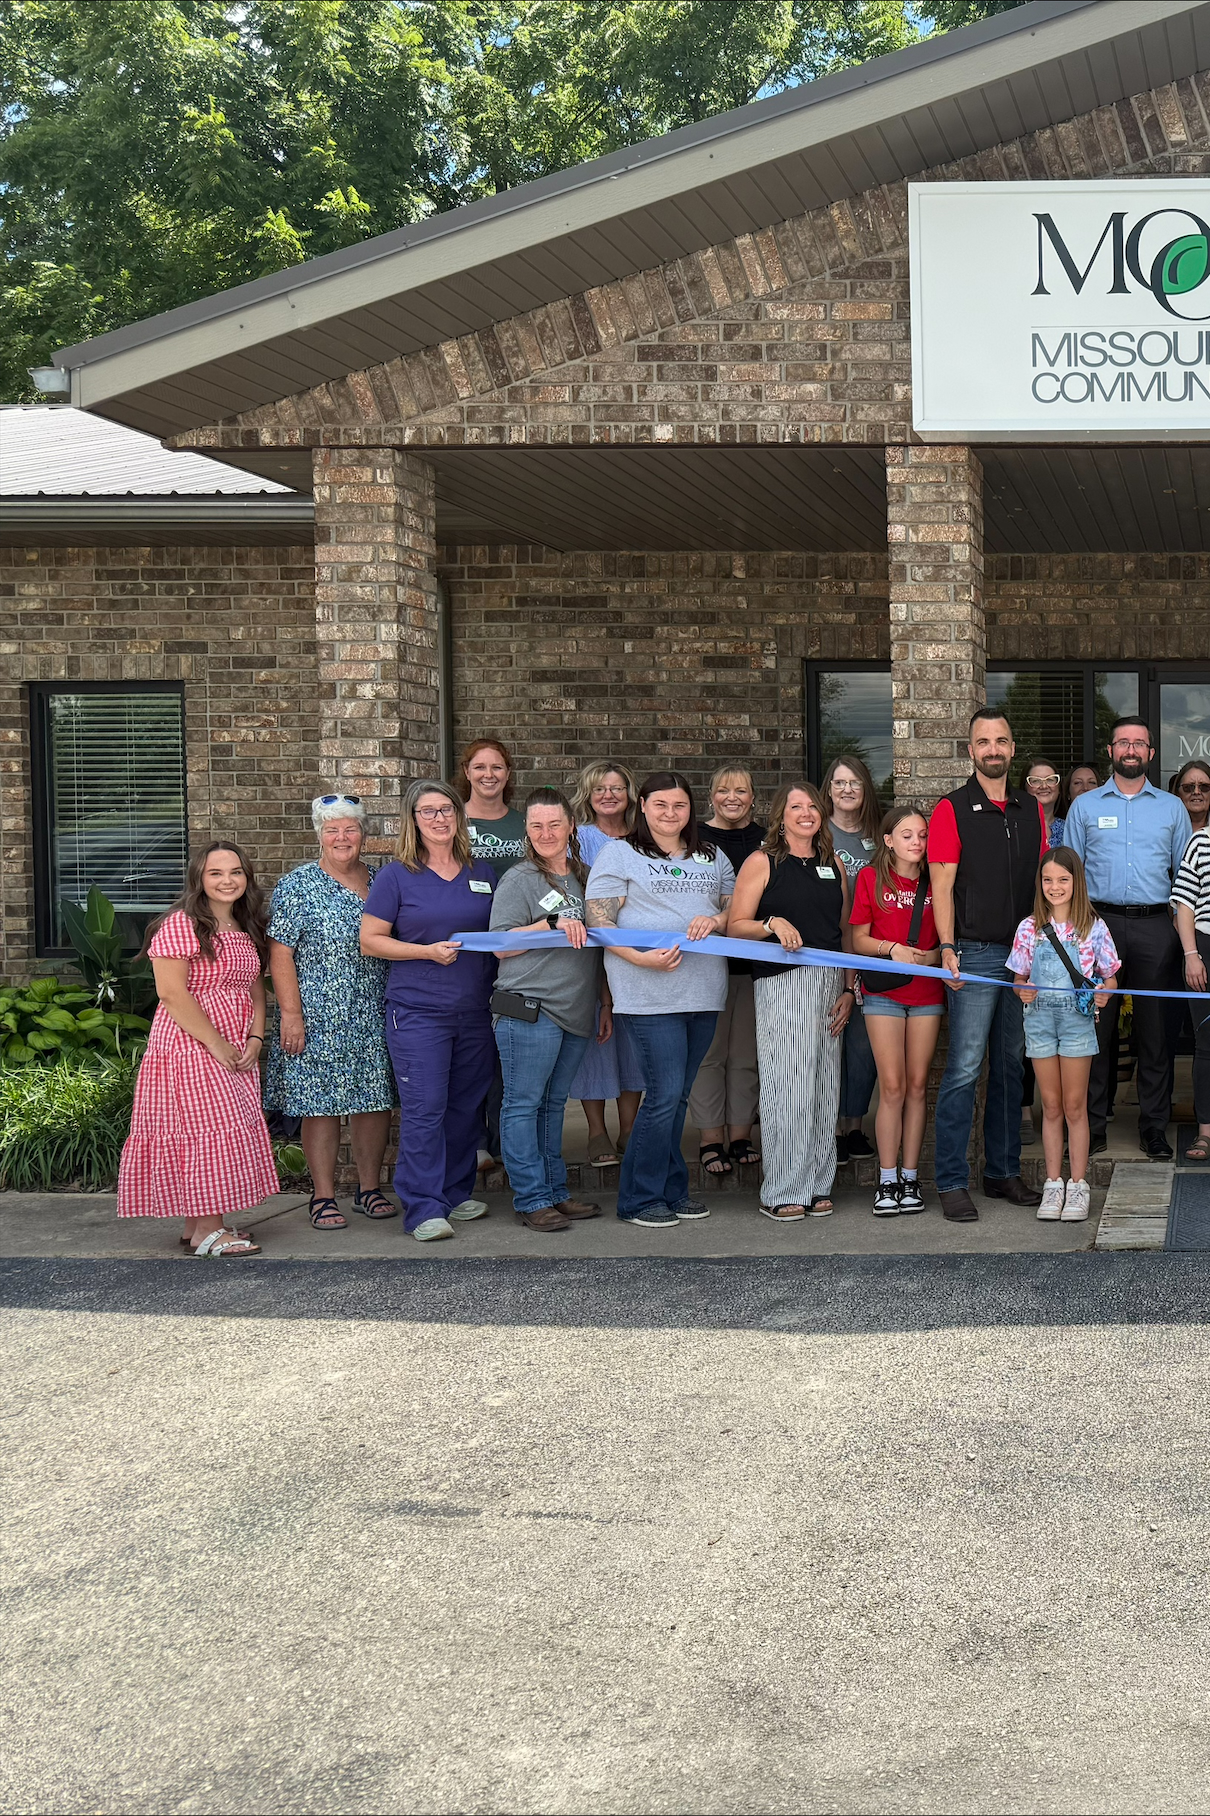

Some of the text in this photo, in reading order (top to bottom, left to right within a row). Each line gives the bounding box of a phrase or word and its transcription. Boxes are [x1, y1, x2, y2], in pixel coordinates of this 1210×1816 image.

[651, 880, 719, 890] MISSOURI OZARKS
[883, 892, 933, 906] OVERCS
